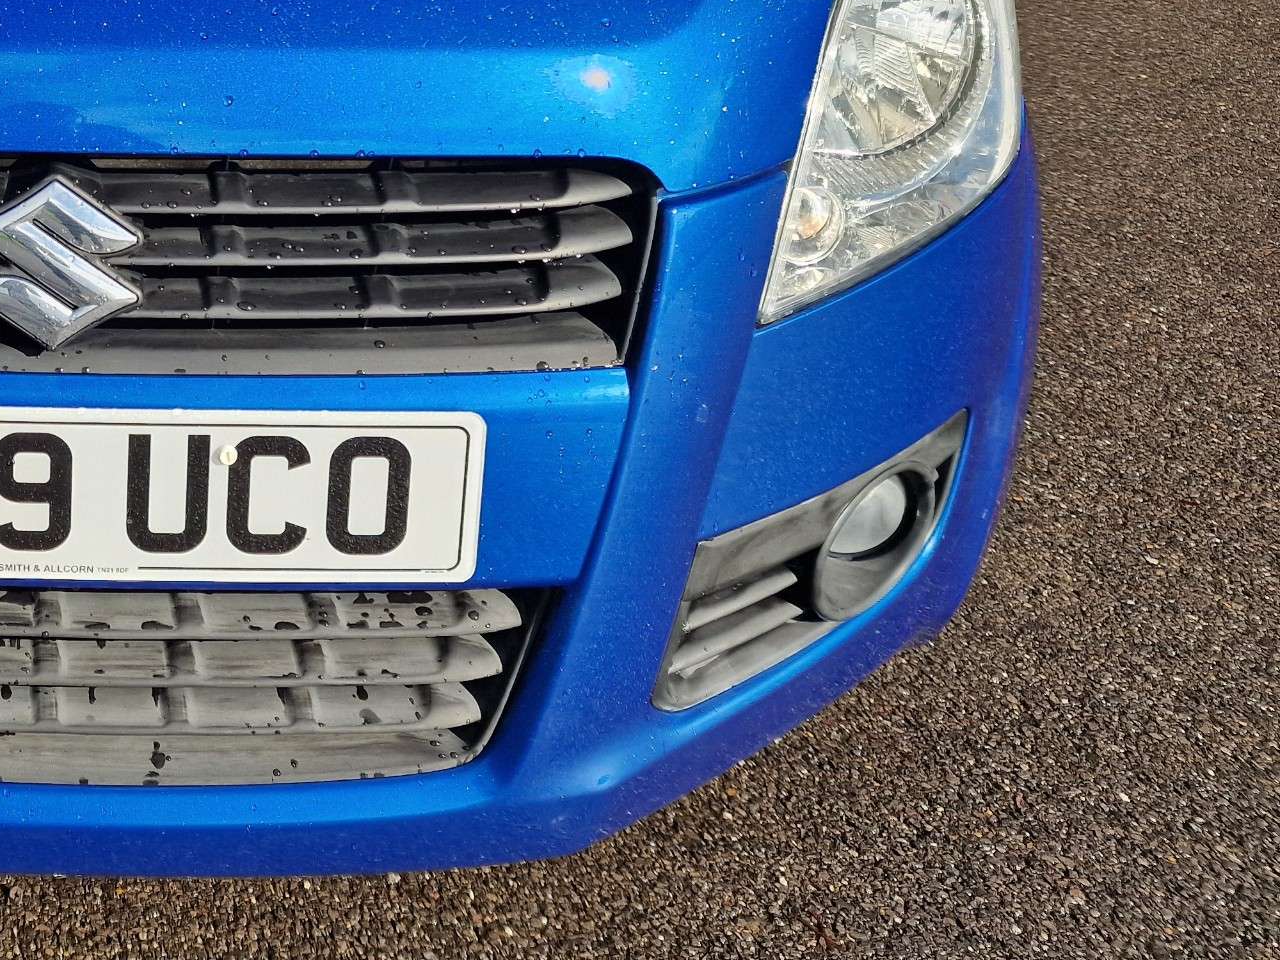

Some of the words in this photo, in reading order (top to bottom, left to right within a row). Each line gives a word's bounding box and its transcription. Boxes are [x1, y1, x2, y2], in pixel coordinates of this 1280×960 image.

[126, 433, 412, 555] UCO
[33, 563, 41, 573] &
[43, 564, 94, 574] ALLCORN
